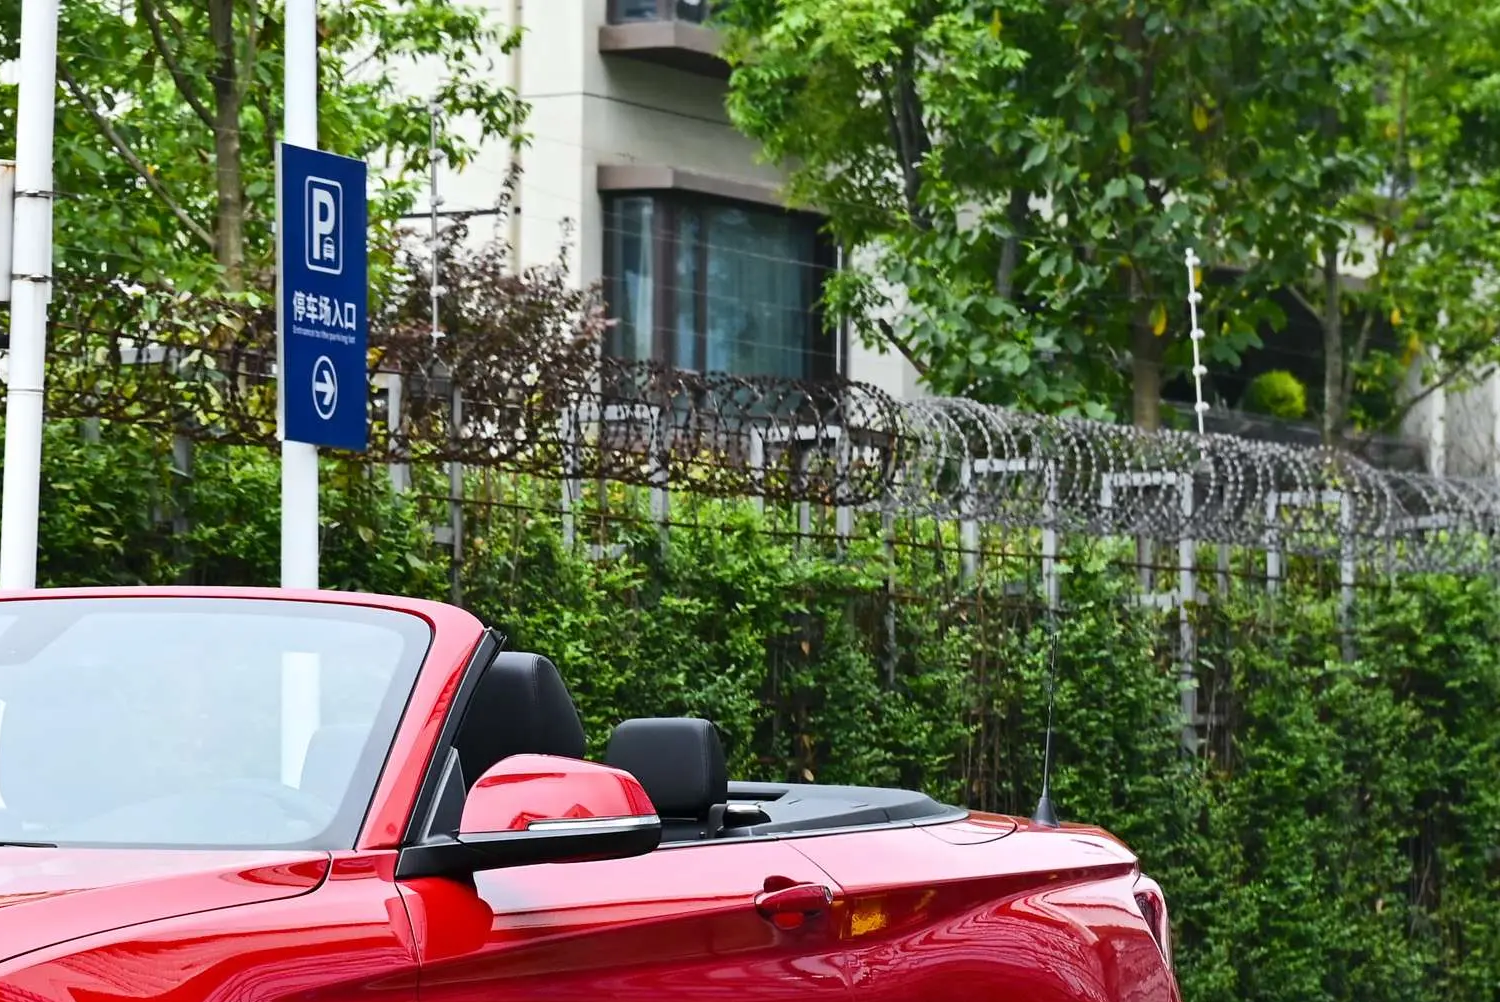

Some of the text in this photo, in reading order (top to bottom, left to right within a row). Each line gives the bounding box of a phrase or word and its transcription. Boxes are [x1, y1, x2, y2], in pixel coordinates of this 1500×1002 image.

[313, 187, 335, 260] P
[293, 290, 356, 331] 停车场入口
